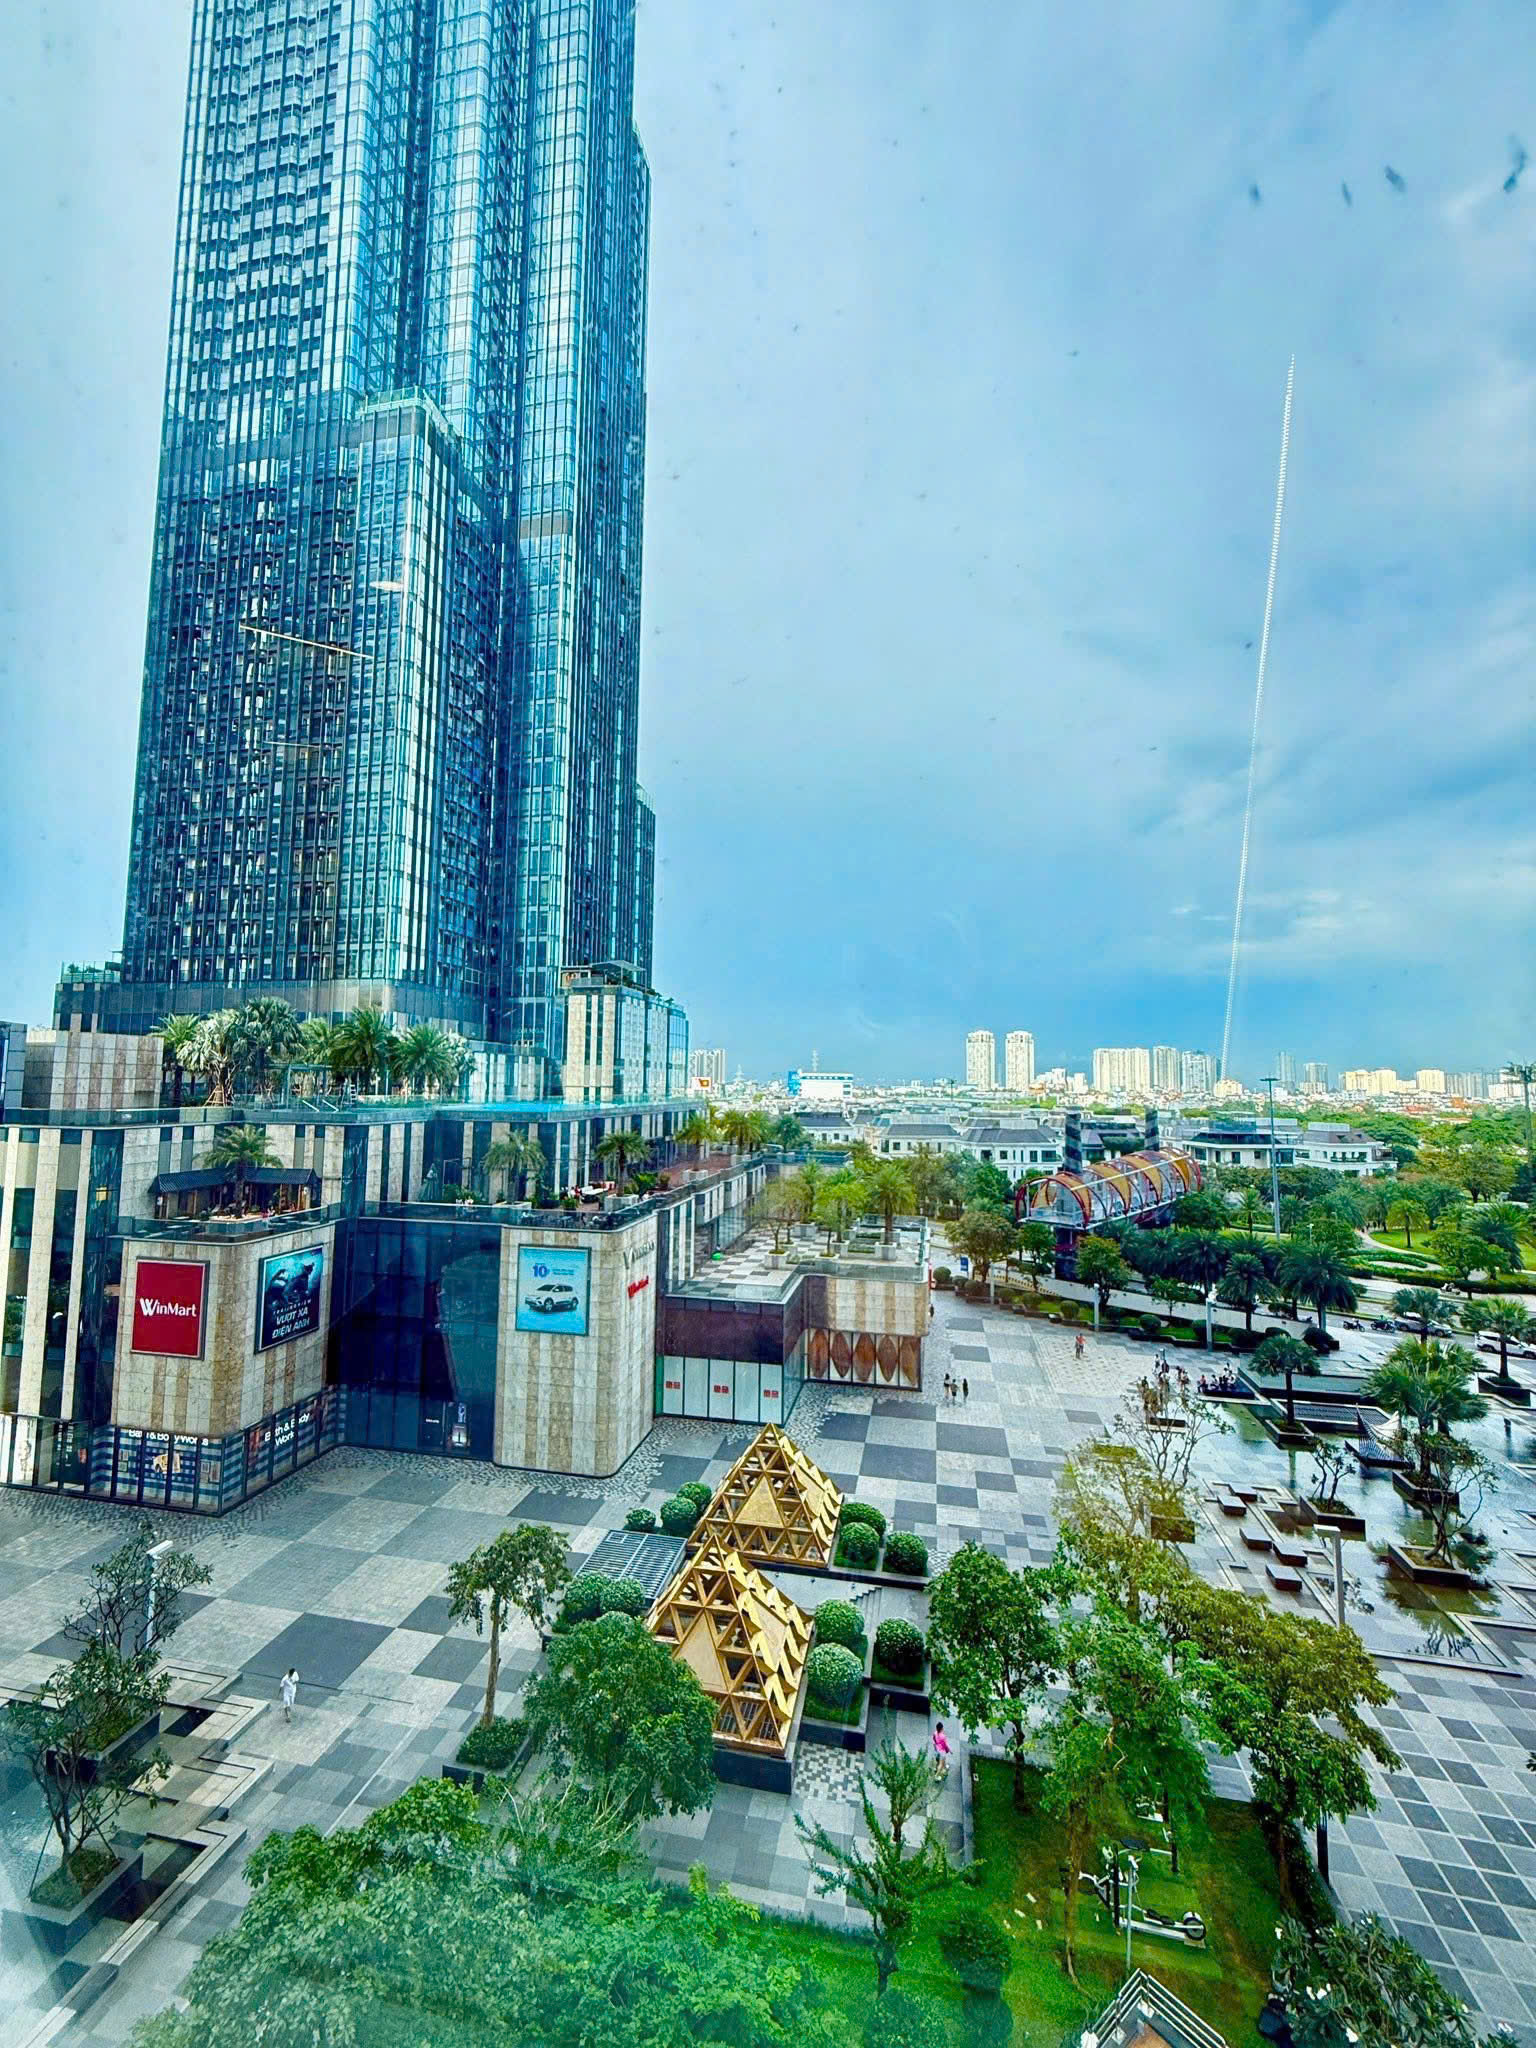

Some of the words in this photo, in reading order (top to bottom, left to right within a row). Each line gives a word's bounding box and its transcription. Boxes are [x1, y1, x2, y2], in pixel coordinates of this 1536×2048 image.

[140, 1297, 197, 1318] WinMart
[264, 1426, 284, 1442] Bth
[290, 1412, 310, 1429] Bdy
[156, 1432, 178, 1444] Boy
[178, 1435, 209, 1446] Wors
